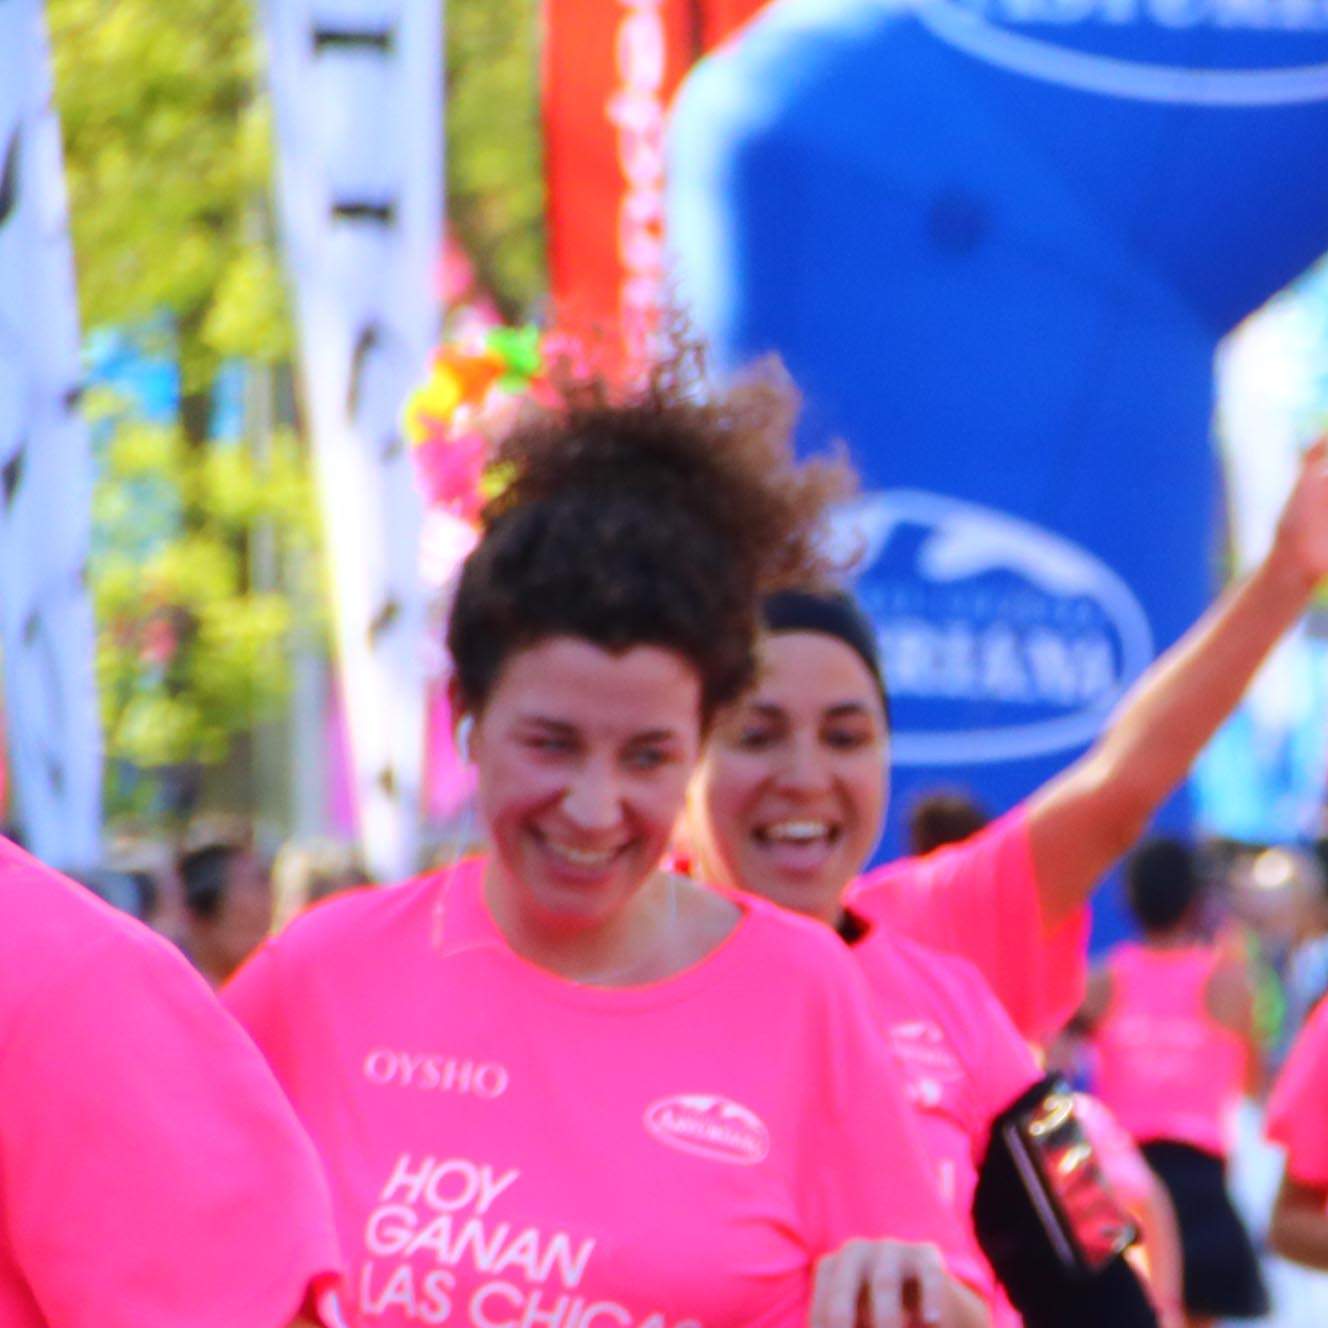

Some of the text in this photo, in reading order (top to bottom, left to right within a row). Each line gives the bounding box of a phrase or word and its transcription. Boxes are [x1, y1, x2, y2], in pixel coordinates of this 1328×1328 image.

[363, 1049, 509, 1098] OYSHO
[381, 1152, 520, 1214] HOY
[365, 1204, 597, 1289] GANAN
[361, 1260, 455, 1324] LAS
